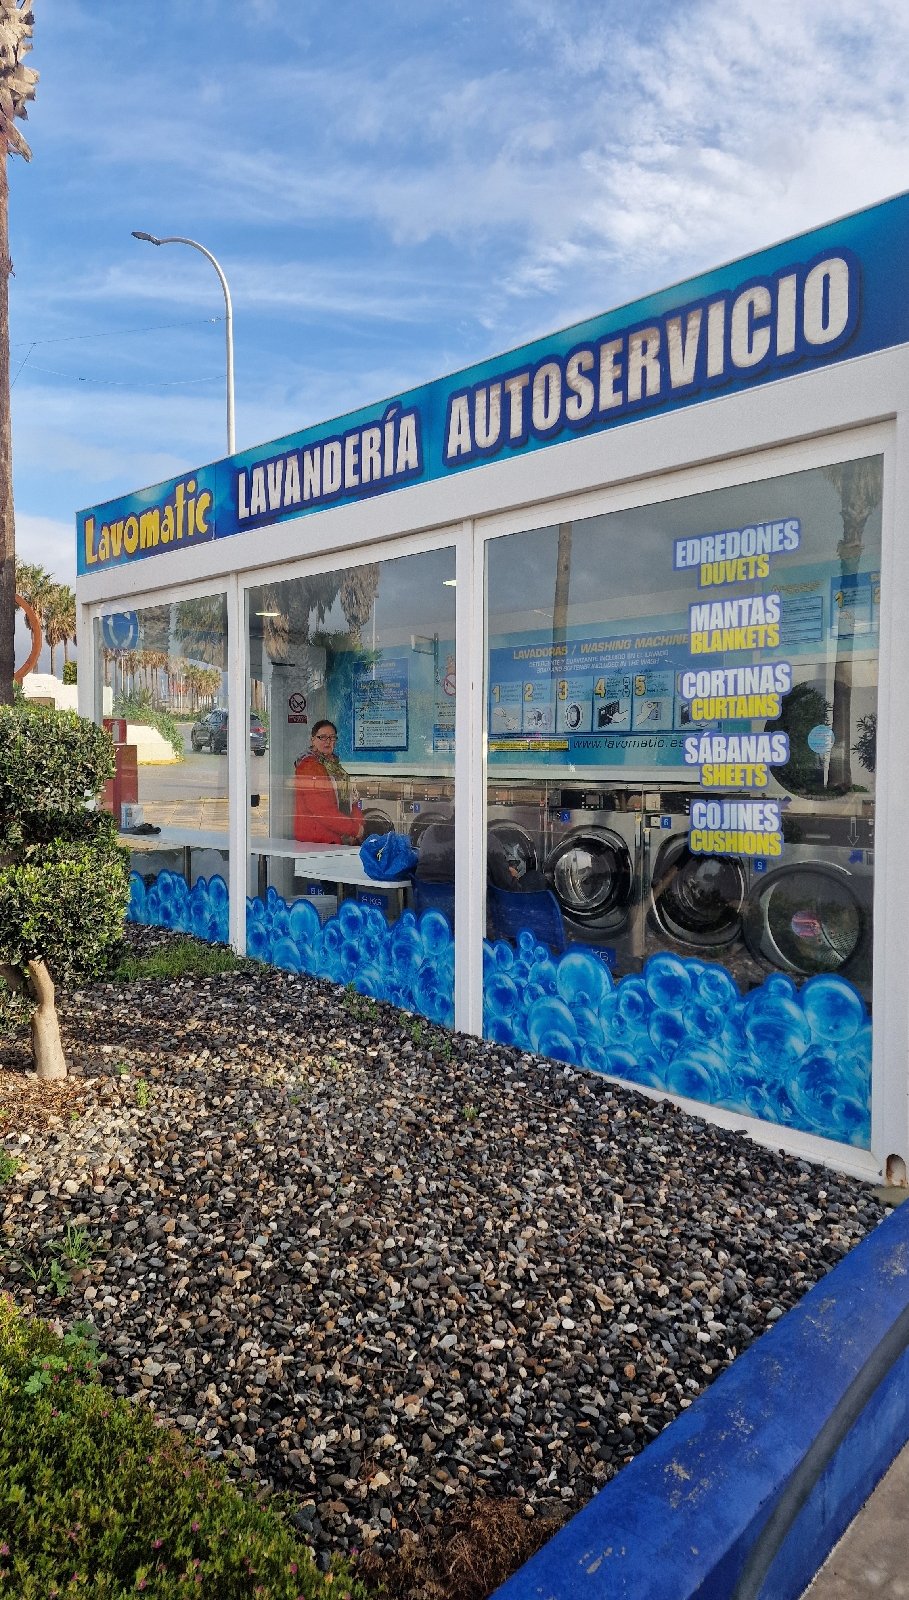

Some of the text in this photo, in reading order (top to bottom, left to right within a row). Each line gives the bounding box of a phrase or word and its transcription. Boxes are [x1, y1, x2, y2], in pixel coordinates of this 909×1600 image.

[238, 257, 849, 520] LAVANDERÍA AUTOSERVICIO
[85, 480, 212, 565] Lavomatic
[676, 520, 799, 568] EDREDONES
[700, 554, 769, 587] DUVETS
[691, 594, 780, 632] MANTAS
[513, 646, 568, 659] LAVADORAS
[580, 639, 631, 654] WASHING
[691, 624, 780, 654] BLANKETS
[492, 685, 500, 703] 1
[524, 682, 534, 702] 2
[558, 680, 568, 700] 3
[595, 677, 606, 698] 4
[635, 675, 646, 696] 5
[683, 663, 790, 698] CORTINAS
[691, 693, 779, 721] CURTAINS
[685, 732, 786, 763] SÁBANAS
[702, 764, 767, 787] SHEETS
[692, 802, 779, 831] COJINES
[690, 830, 782, 856] CUSHIONS
